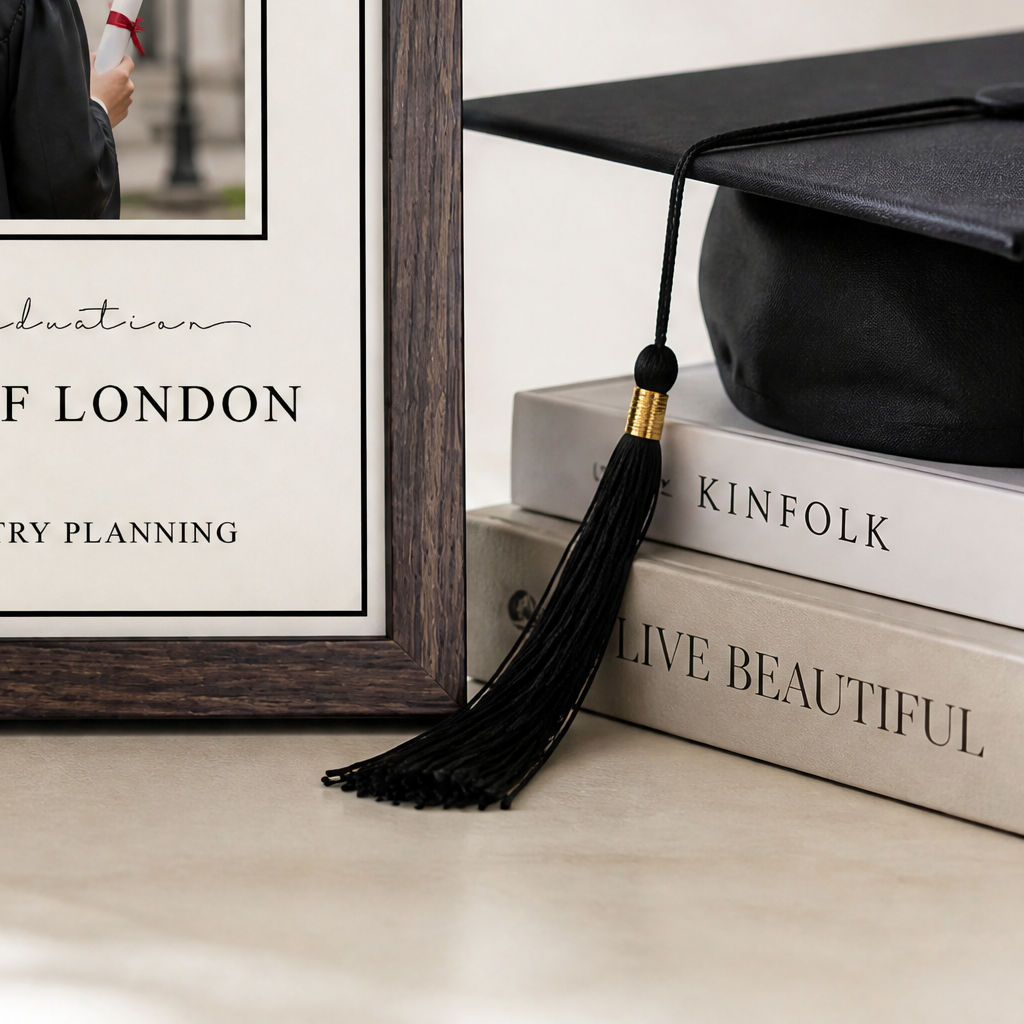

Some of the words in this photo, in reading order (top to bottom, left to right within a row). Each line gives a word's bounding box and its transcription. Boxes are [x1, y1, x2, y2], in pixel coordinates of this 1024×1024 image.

[55, 384, 302, 423] LONDON
[64, 521, 238, 544] PLANNING
[698, 474, 891, 552] KINFOLK
[615, 617, 711, 682] LIVE
[726, 644, 985, 758] BEAUTIFUL
